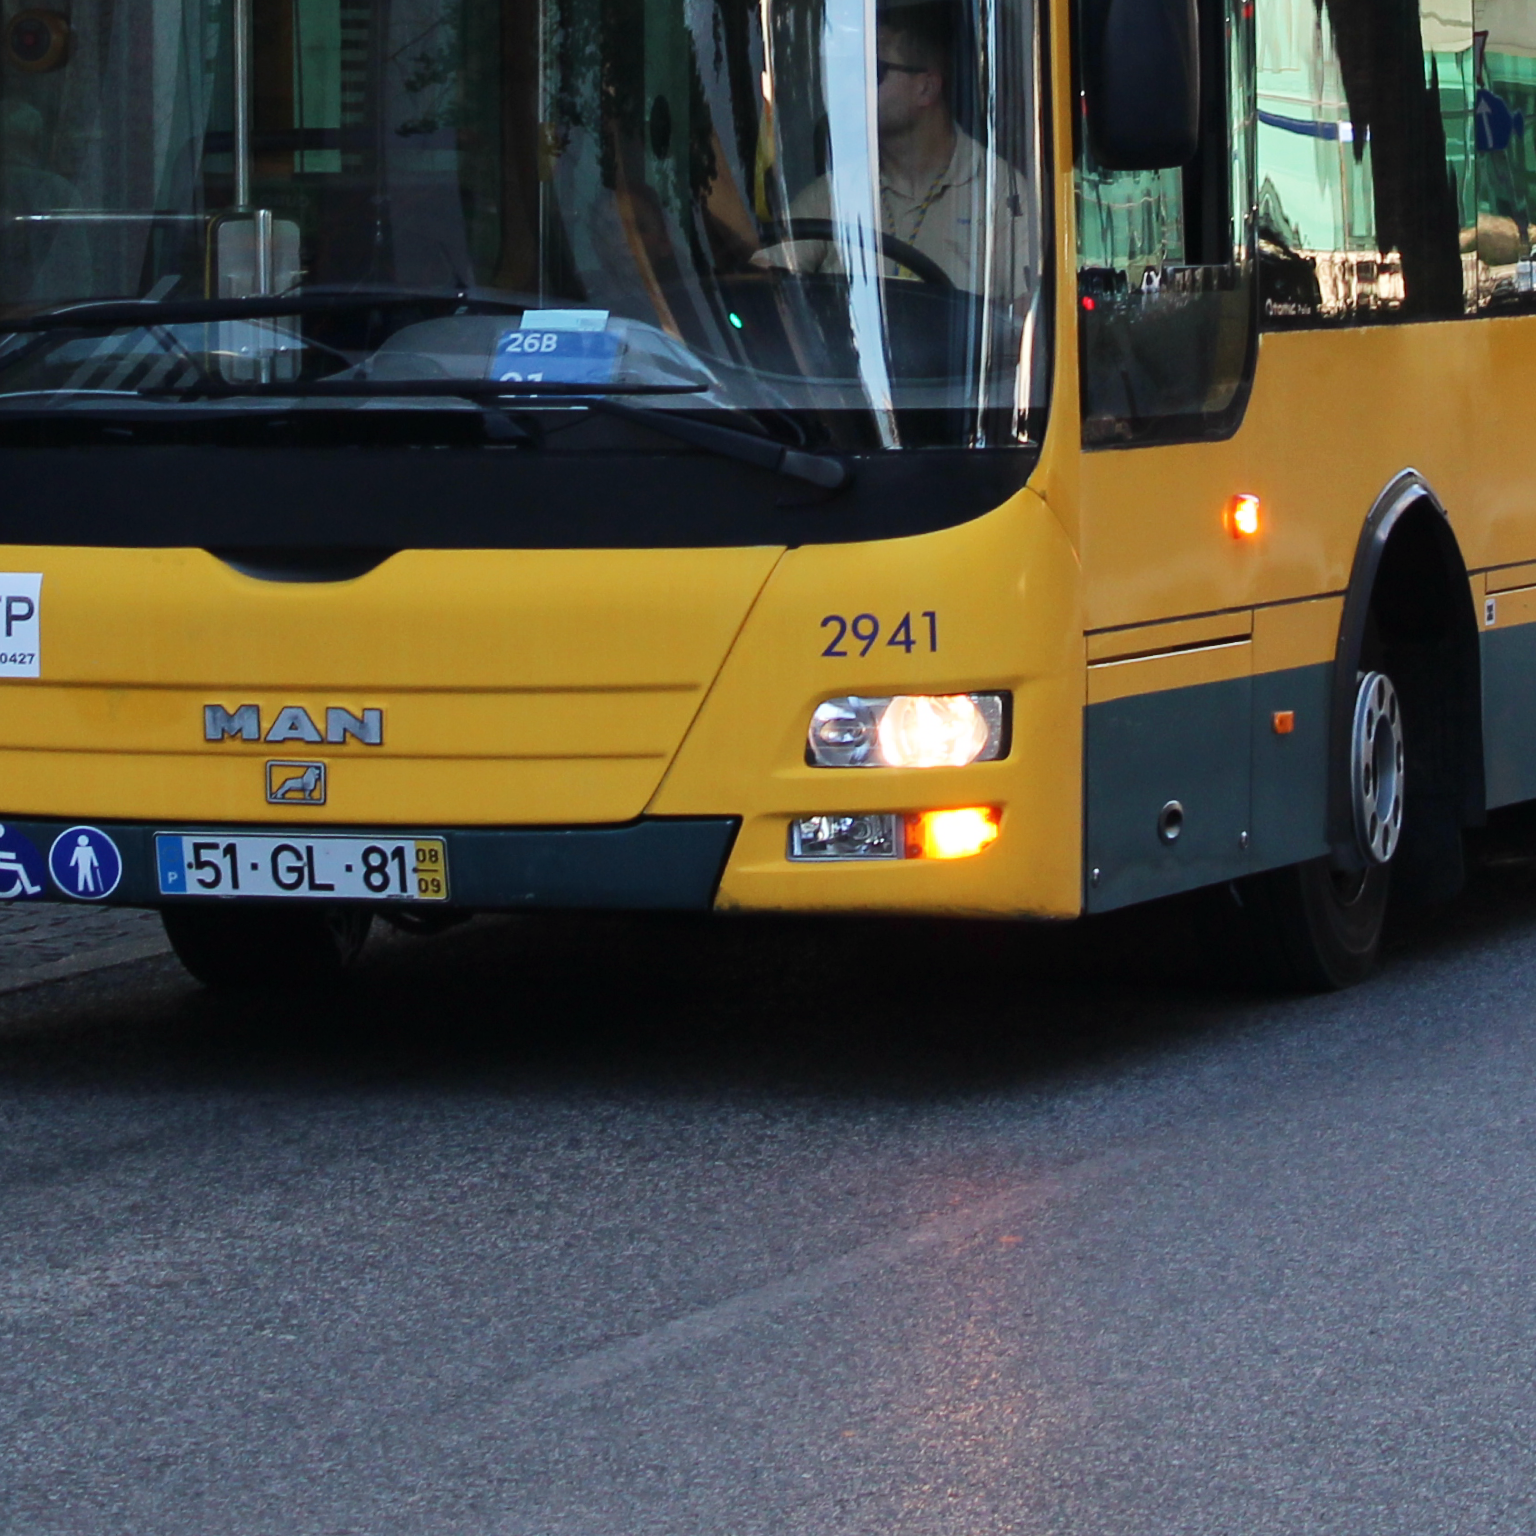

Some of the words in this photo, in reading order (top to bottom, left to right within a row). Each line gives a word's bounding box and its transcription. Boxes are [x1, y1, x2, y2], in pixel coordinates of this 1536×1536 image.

[505, 333, 558, 353] 26B
[819, 611, 939, 658] 2941
[201, 704, 384, 746] MAN
[415, 847, 439, 864] 08
[418, 877, 442, 894] 09
